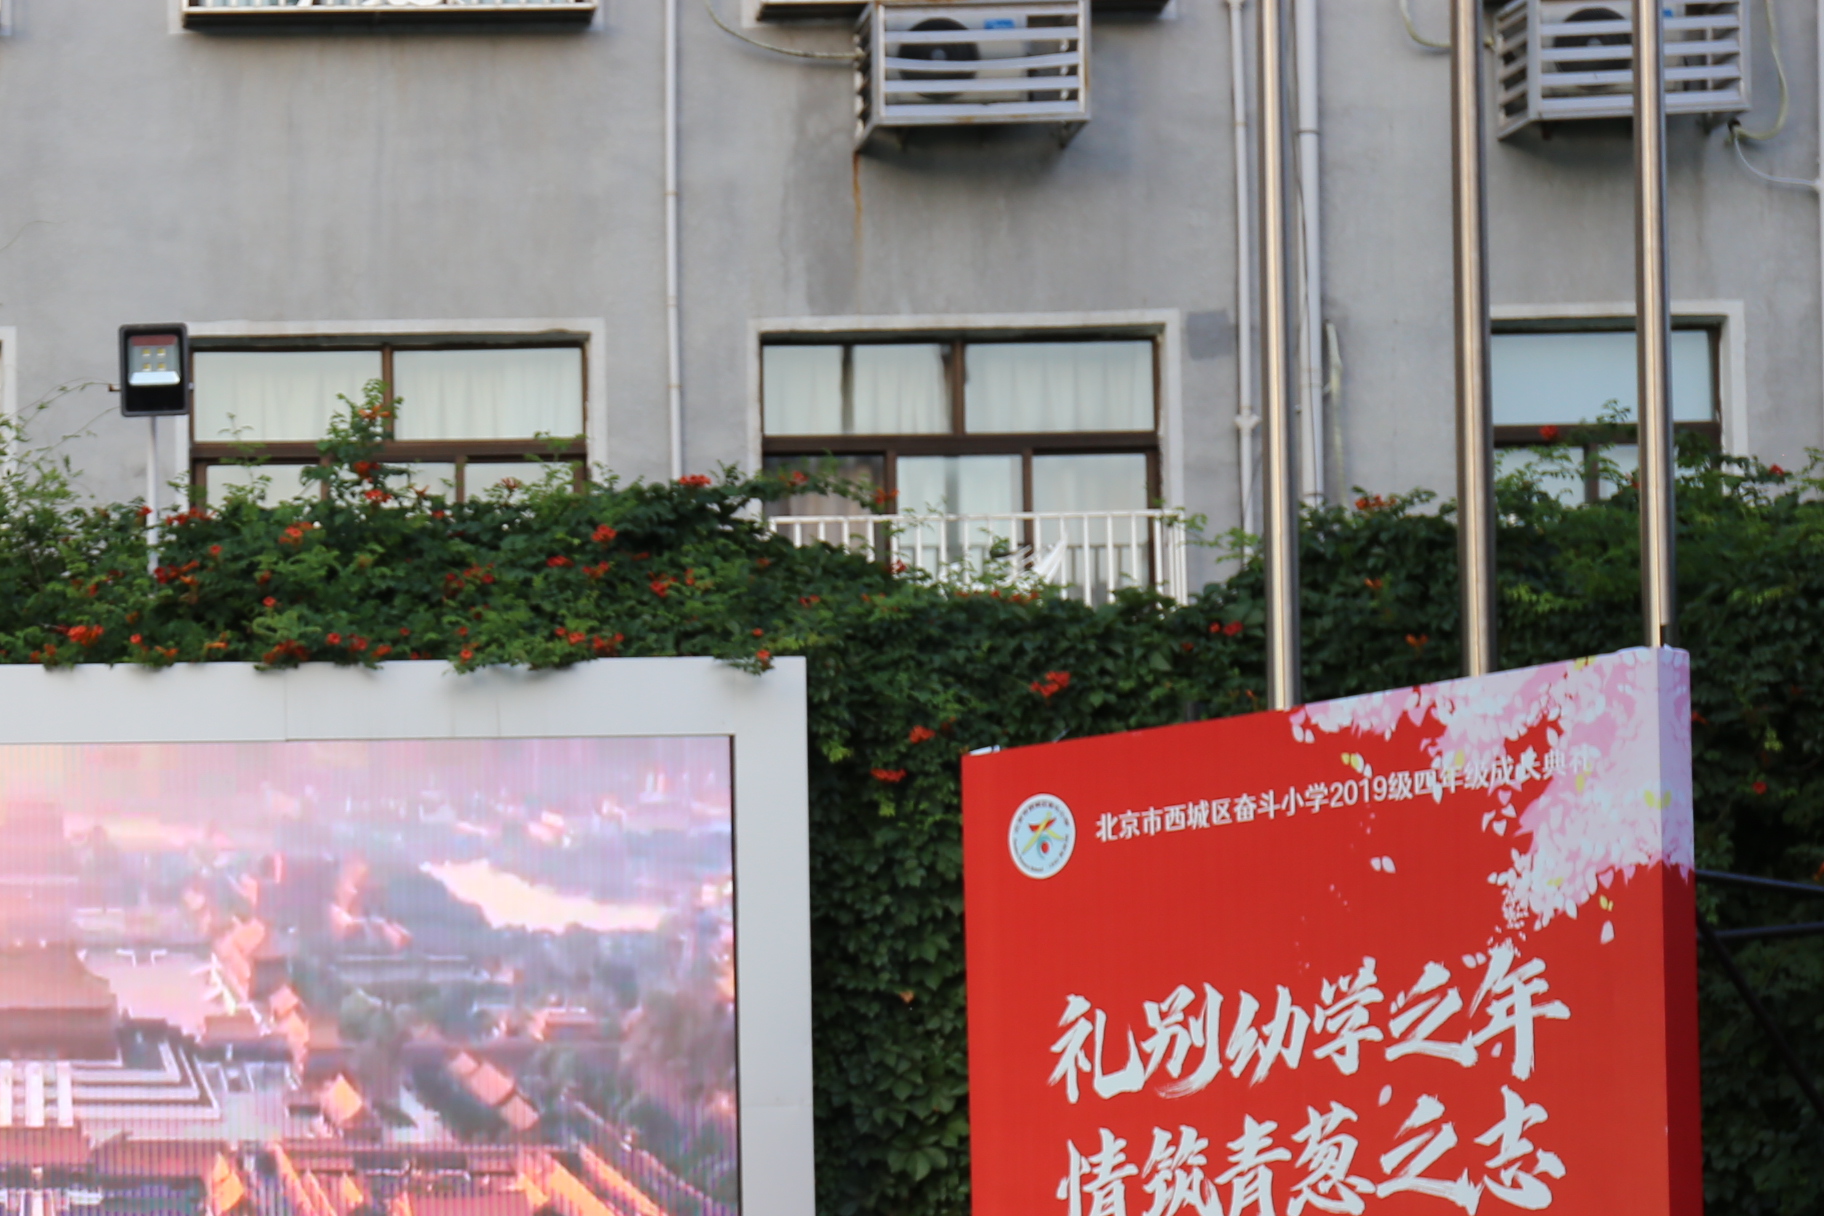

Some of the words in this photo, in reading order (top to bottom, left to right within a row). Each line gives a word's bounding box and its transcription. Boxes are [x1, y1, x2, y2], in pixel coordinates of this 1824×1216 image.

[1048, 943, 1571, 1105] 礼别幼学之年
